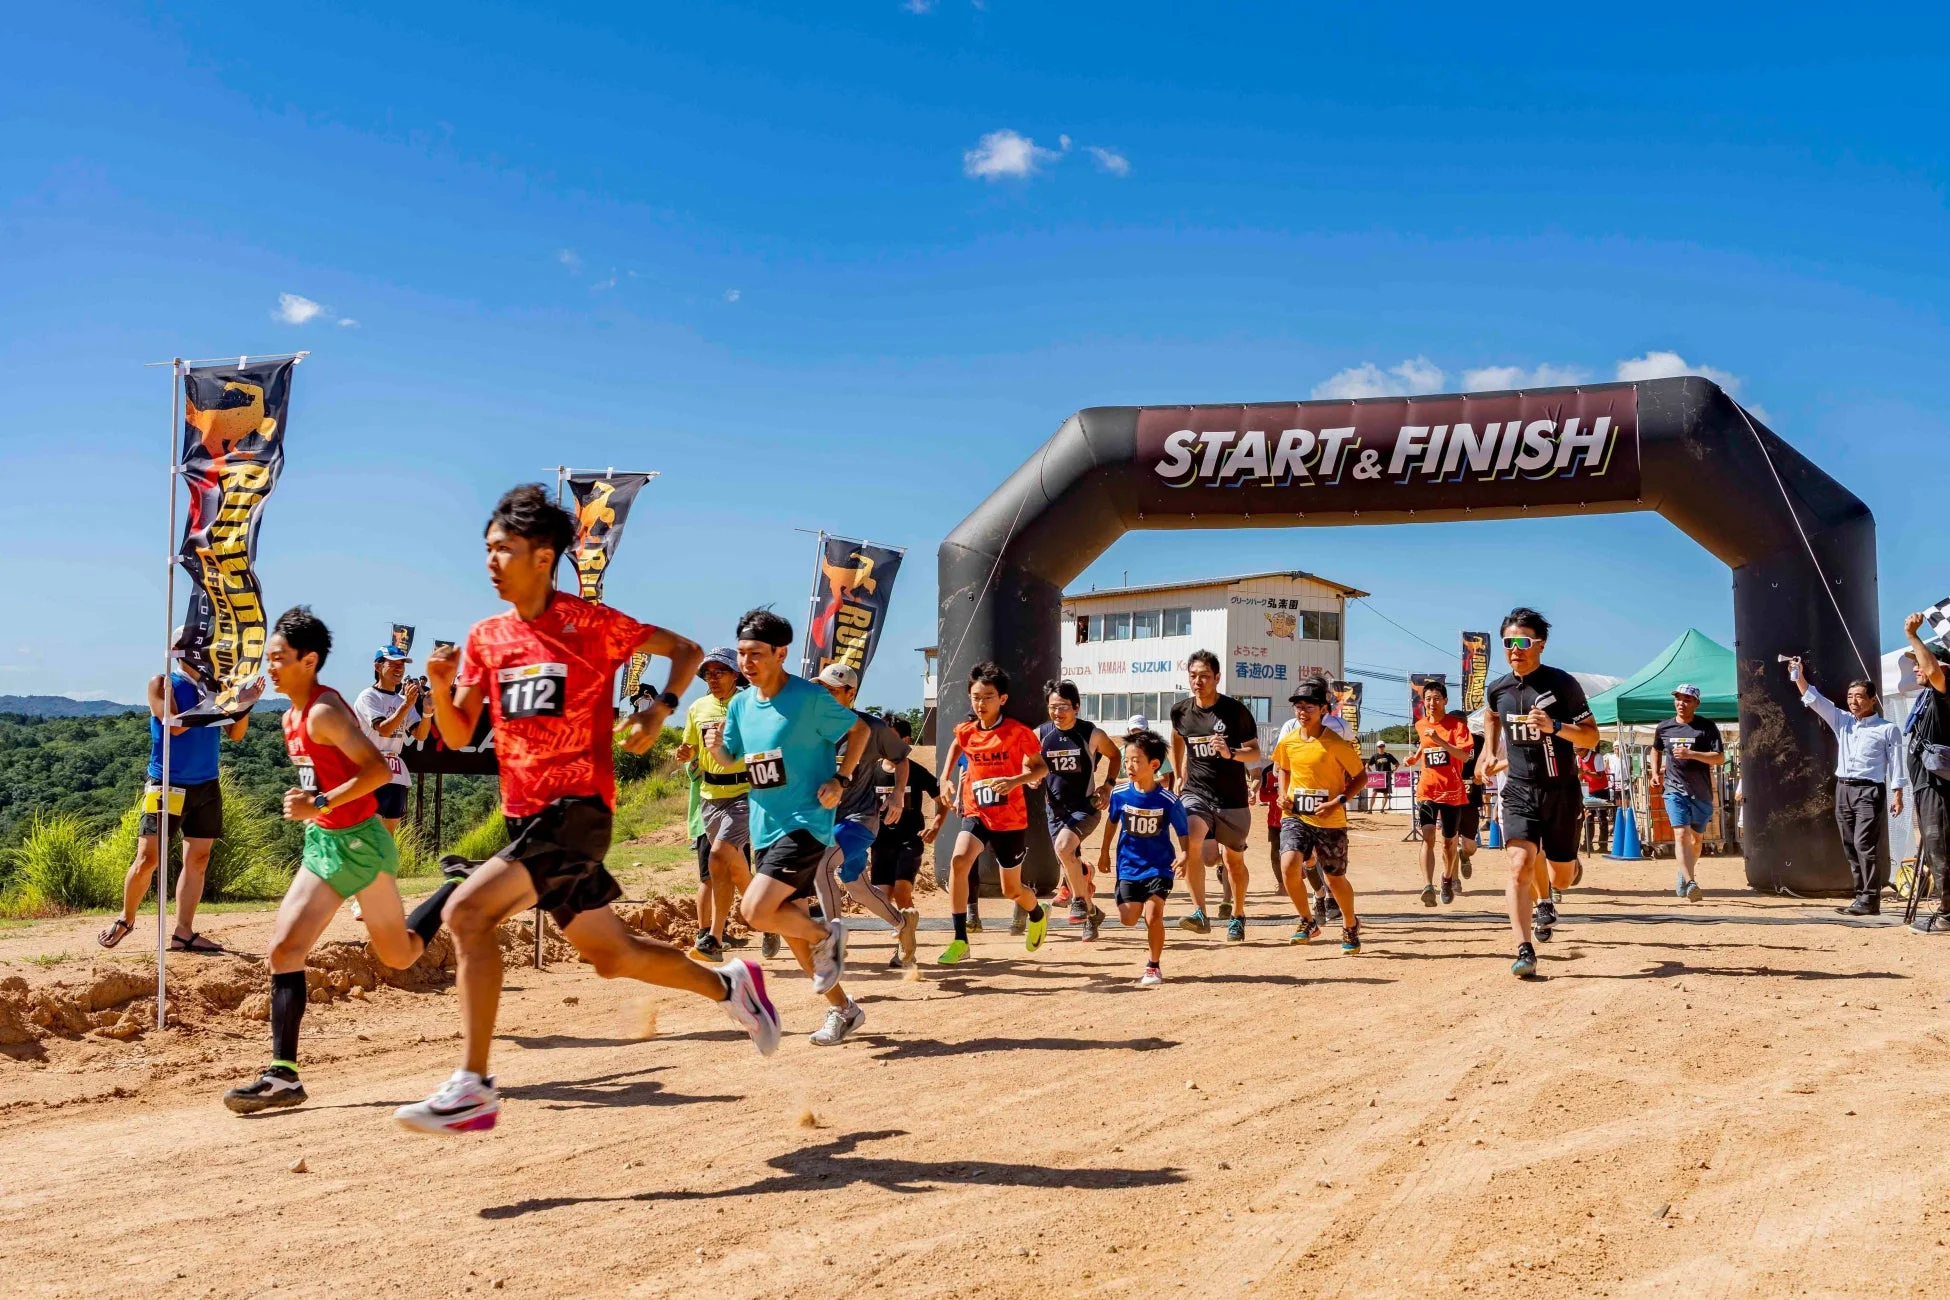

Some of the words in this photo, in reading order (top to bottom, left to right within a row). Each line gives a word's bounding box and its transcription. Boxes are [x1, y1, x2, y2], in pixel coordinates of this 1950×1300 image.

[1154, 426, 1357, 479] START
[1353, 449, 1383, 480] &
[1388, 416, 1612, 474] FINISH
[203, 553, 235, 635] OFFROAD
[1233, 645, 1268, 658] ようこそ
[1062, 665, 1092, 677] ONDA
[1097, 660, 1127, 674] YAMAHA
[1131, 660, 1172, 674] SUZUKI
[1236, 661, 1288, 681] 香遊の里
[506, 678, 557, 713] 112
[1509, 723, 1541, 741] 119
[1192, 743, 1217, 758] 106
[1427, 751, 1448, 765] 152
[1051, 756, 1077, 771] 123
[748, 761, 780, 785] 104
[1296, 796, 1324, 812] 105
[1128, 817, 1158, 834] 108
